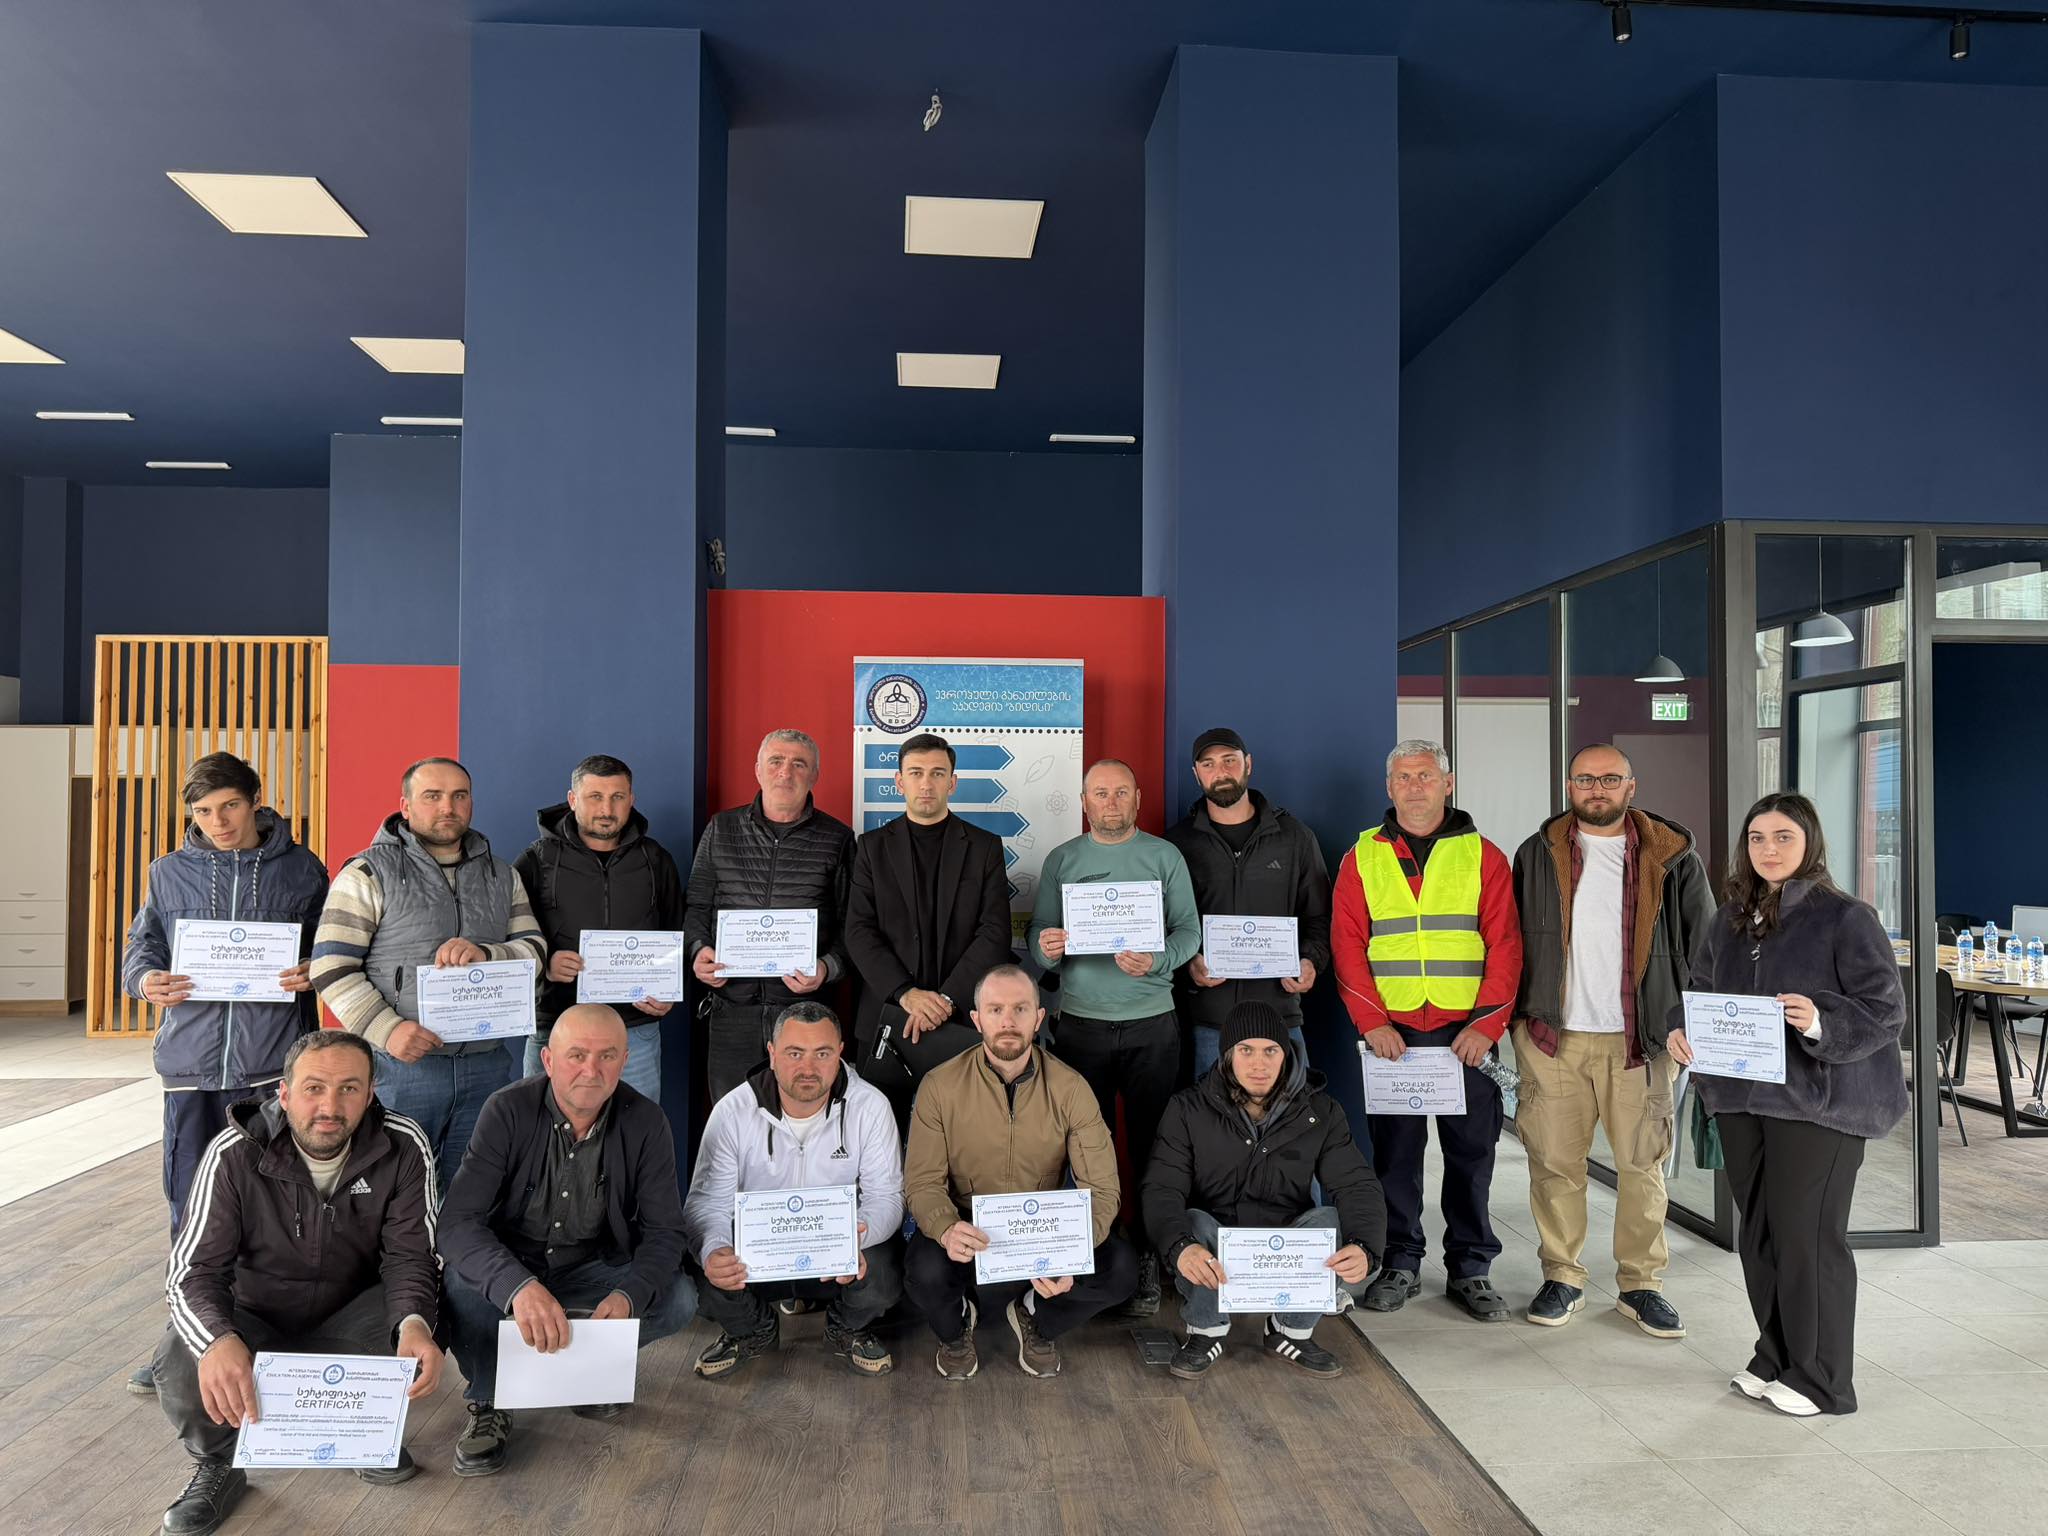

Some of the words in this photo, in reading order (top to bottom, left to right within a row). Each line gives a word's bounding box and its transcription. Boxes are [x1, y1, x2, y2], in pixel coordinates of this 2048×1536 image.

[935, 690, 999, 700] ევროპული
[1001, 690, 1072, 701] განათლების
[952, 701, 1003, 712] აკადემია
[1655, 702, 1684, 718] EXIT
[210, 952, 265, 961] CERTIFICATE
[452, 992, 503, 1002] CERTIFICATE
[1712, 1027, 1756, 1037] CERTIFICATE
[1007, 1217, 1060, 1227] სერტიფიკატი
[771, 1223, 824, 1234] CERTIFICATE
[1008, 1225, 1060, 1236] CERTIFICATE
[1252, 1261, 1303, 1269] CERTIFICATE
[297, 1387, 366, 1400] სერტიფიკატი
[295, 1399, 364, 1410] CERTIFICATE
